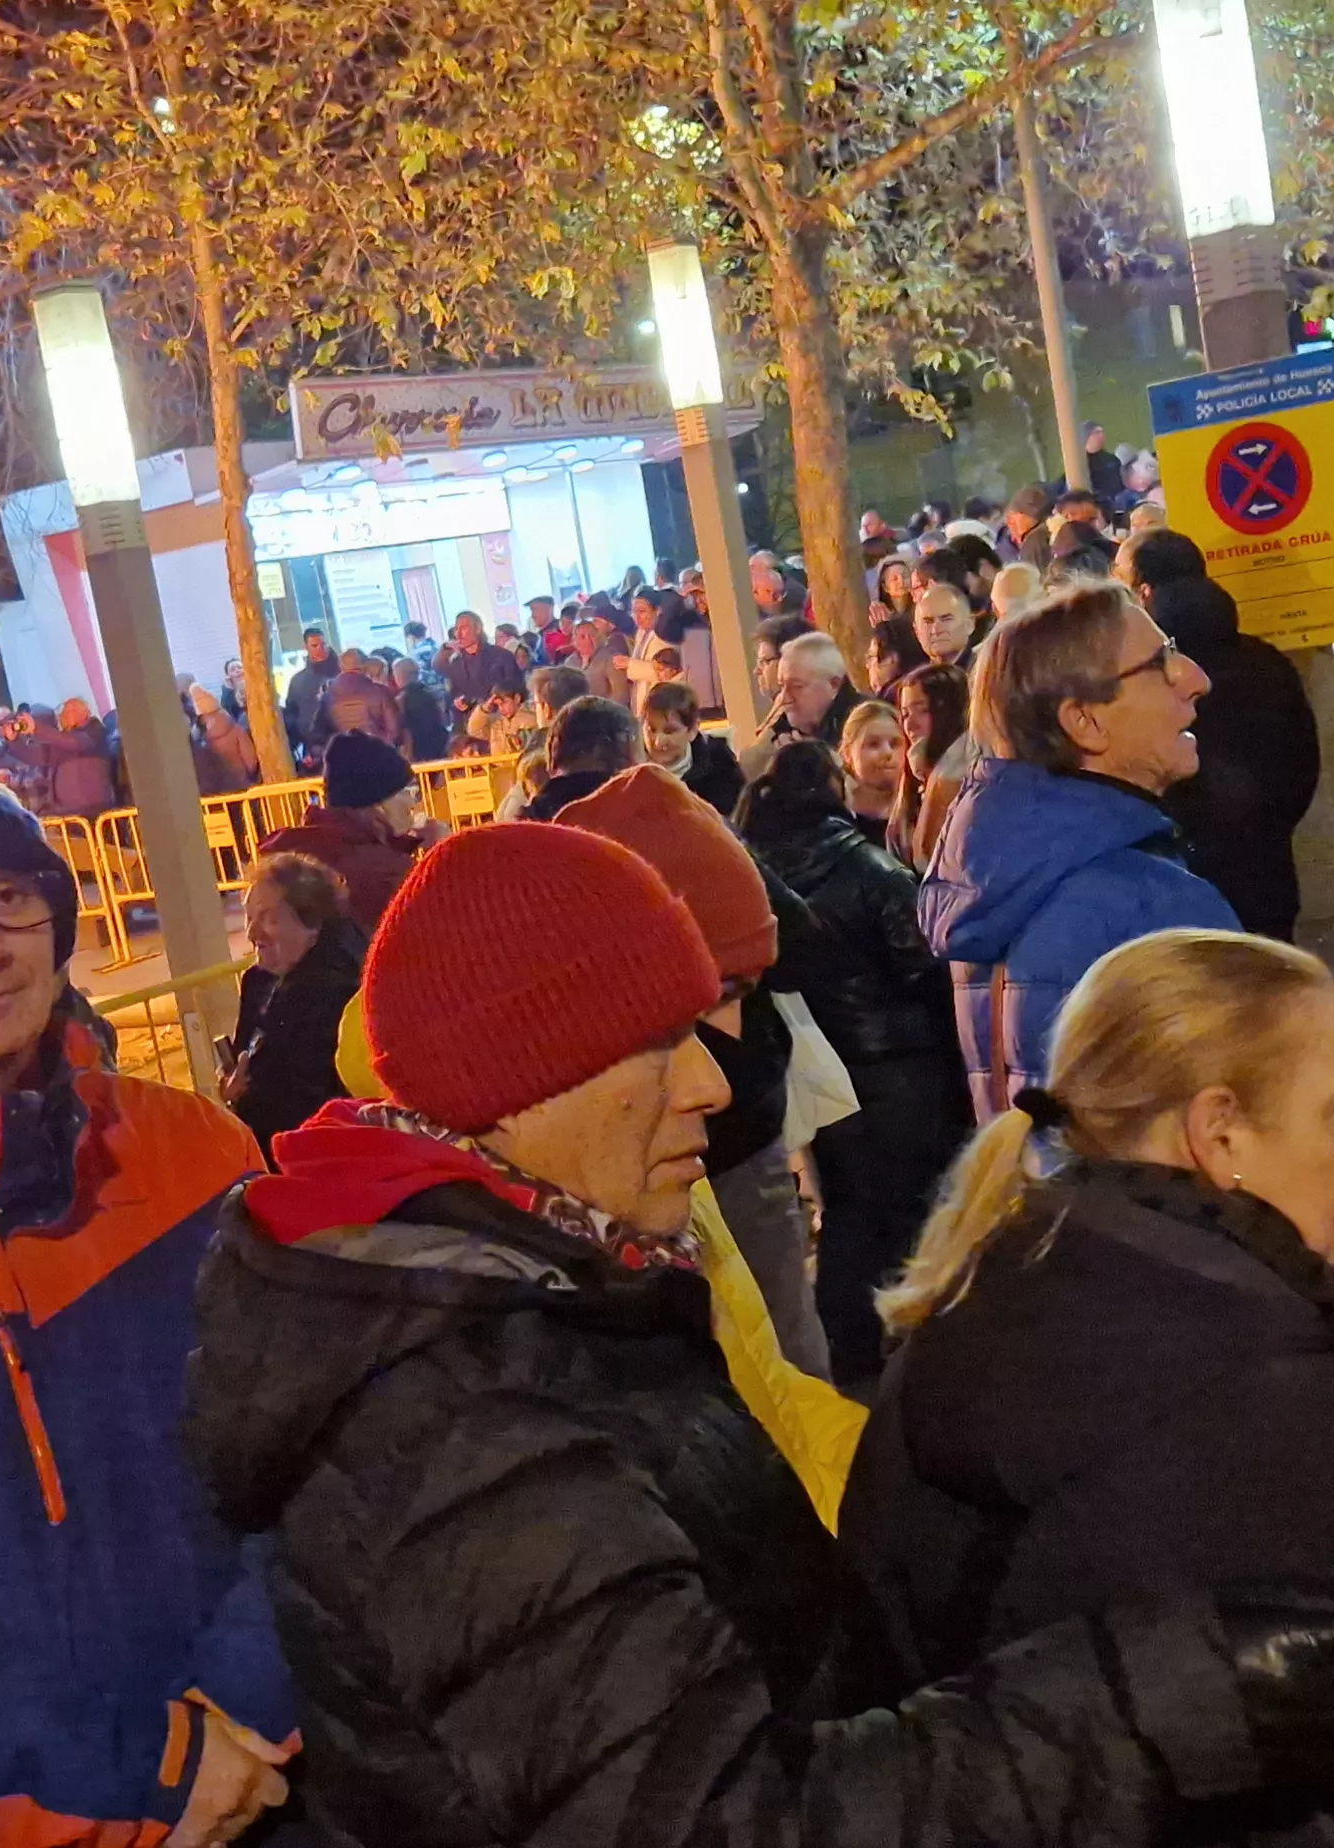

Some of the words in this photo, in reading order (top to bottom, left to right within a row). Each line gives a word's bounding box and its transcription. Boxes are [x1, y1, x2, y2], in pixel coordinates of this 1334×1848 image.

[1196, 376, 1270, 400] Ayuntamiento
[1273, 373, 1287, 385] de
[1290, 364, 1334, 380] Huesca
[1216, 393, 1267, 413] POLICÍA
[1270, 385, 1313, 402] LOCAL
[1206, 540, 1282, 561] RETIRADA
